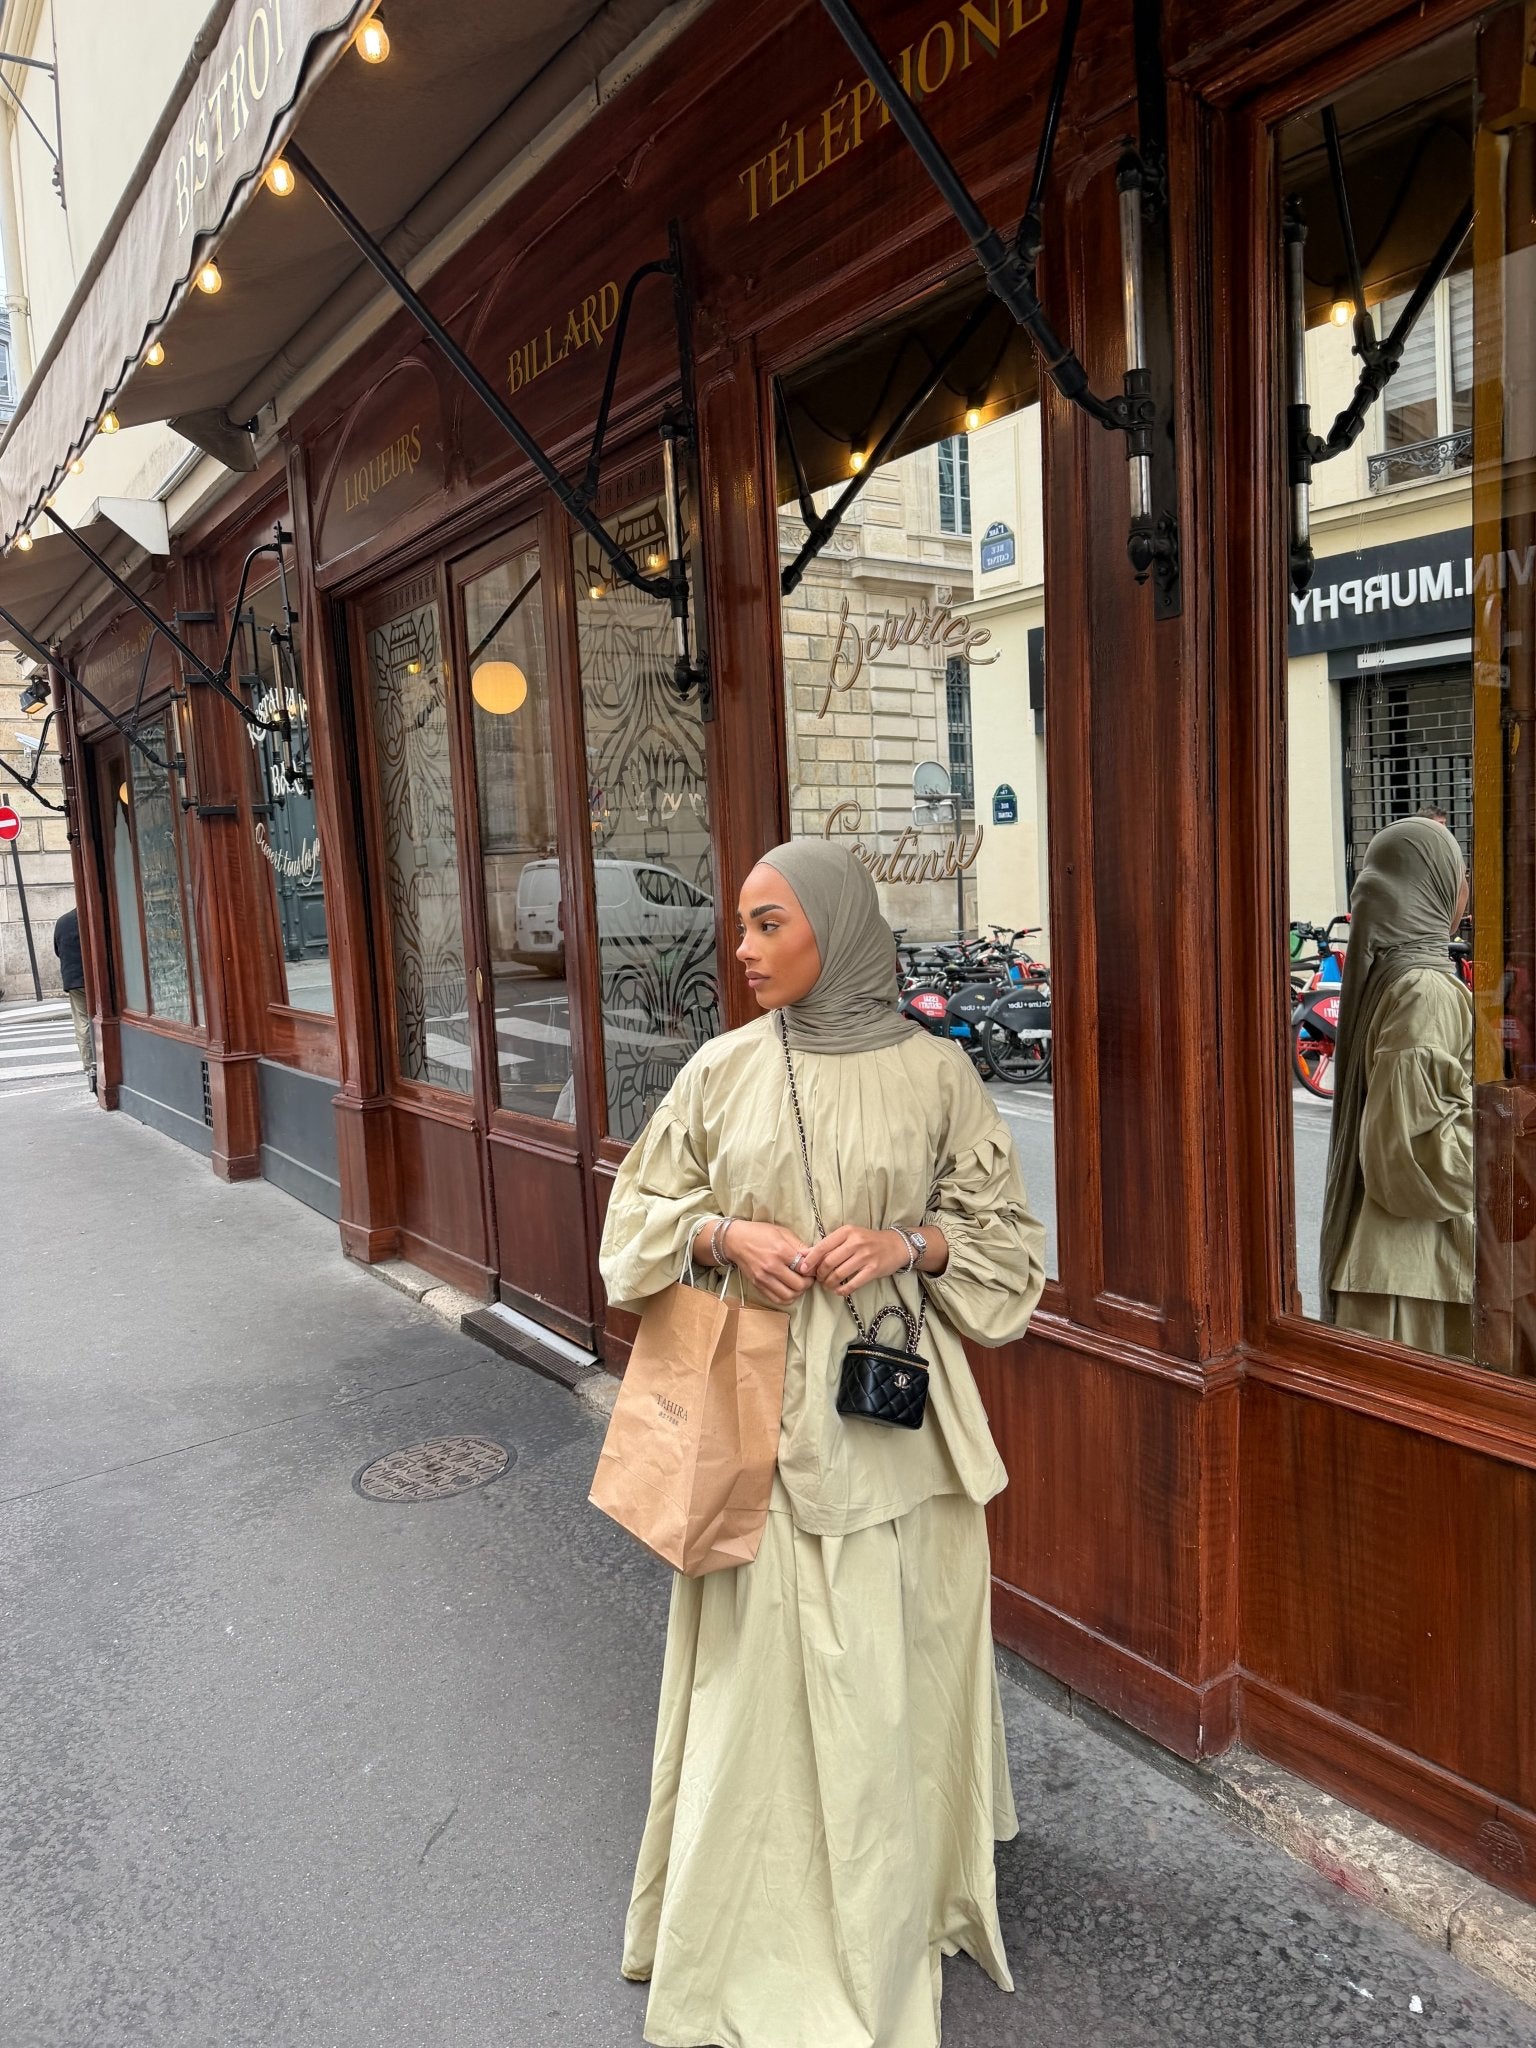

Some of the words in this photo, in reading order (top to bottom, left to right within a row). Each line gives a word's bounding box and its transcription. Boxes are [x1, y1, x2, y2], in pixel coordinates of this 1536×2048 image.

[507, 281, 620, 395] BILLARD
[343, 424, 422, 512] LIQUEURS
[817, 593, 1002, 719] Service
[283, 850, 301, 877] tous
[656, 1392, 688, 1422] TAHIRA
